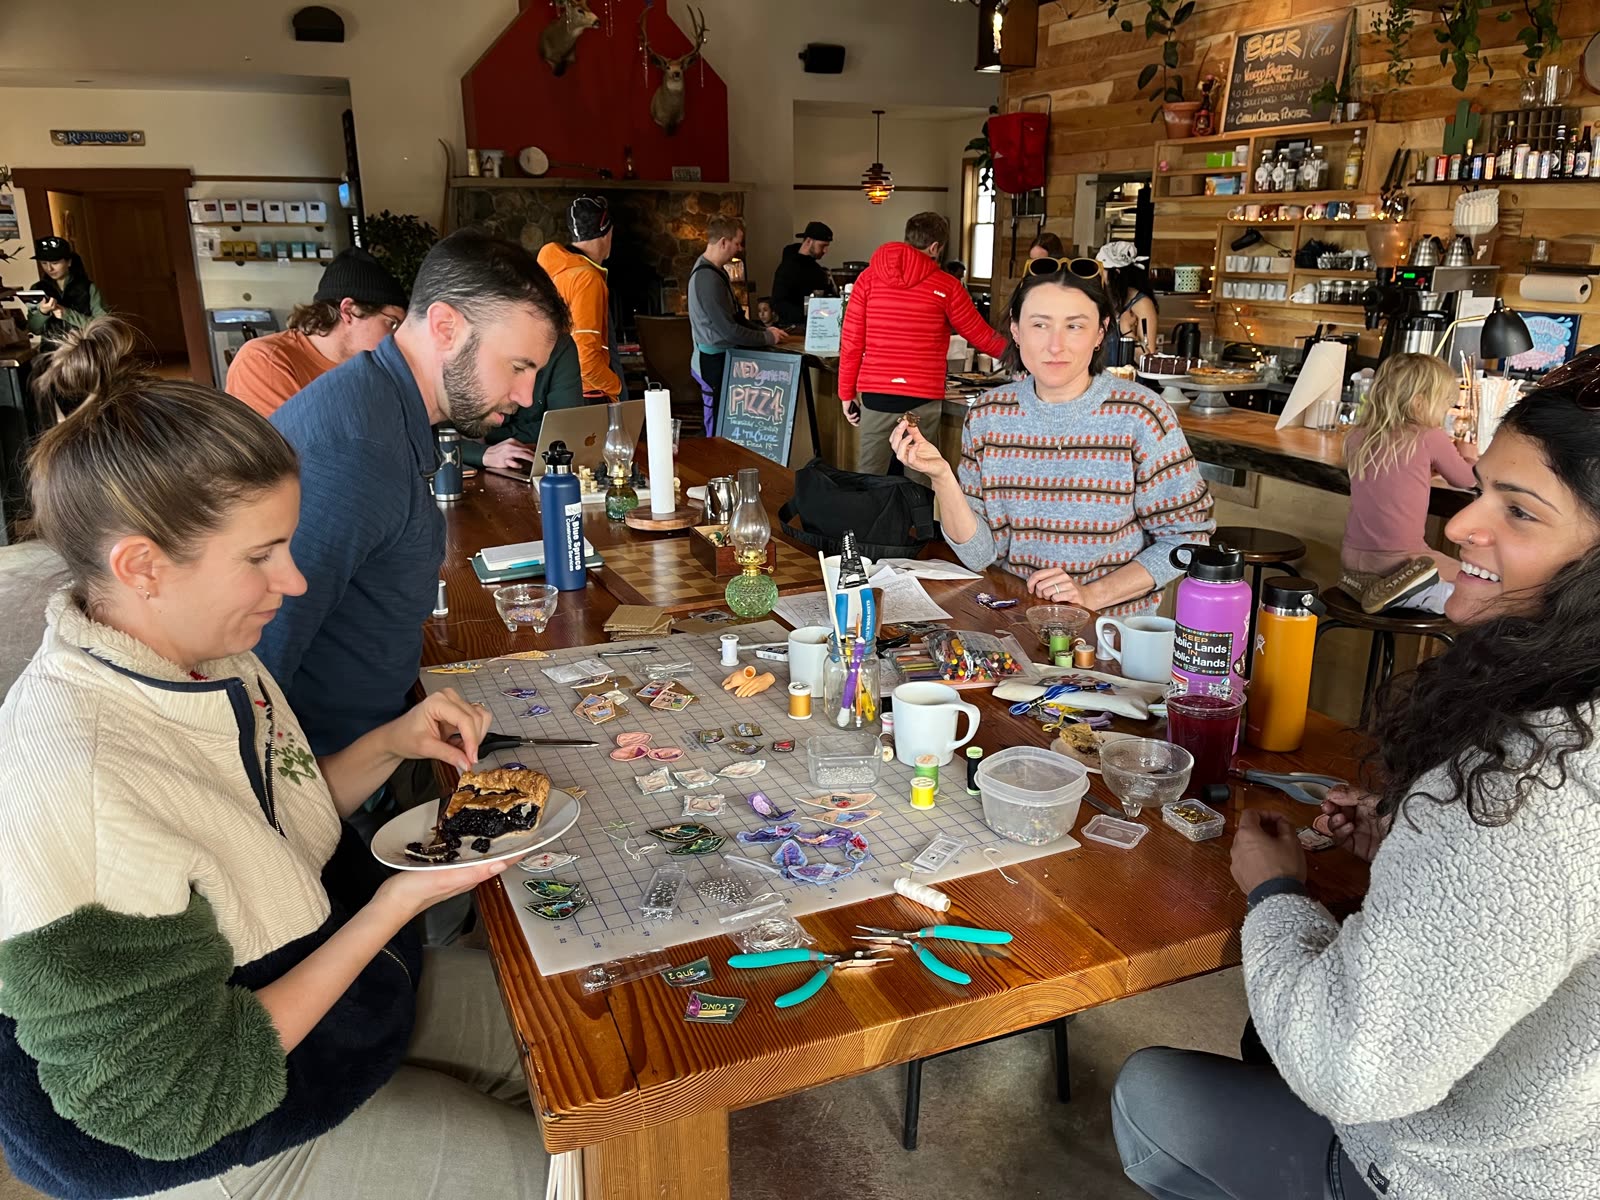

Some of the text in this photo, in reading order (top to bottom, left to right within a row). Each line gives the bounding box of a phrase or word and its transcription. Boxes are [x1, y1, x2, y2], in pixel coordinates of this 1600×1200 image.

[1243, 29, 1302, 62] BEER
[1320, 45, 1336, 56] TAP
[68, 131, 128, 144] RESTROOMS
[730, 386, 784, 423] PIZZA
[731, 427, 741, 439] 4
[572, 521, 582, 571] Blue Spruce
[1182, 632, 1208, 643] KEEP
[1194, 642, 1227, 654] Lands
[1192, 656, 1226, 668] Hands
[701, 1003, 735, 1011] ONDA?
